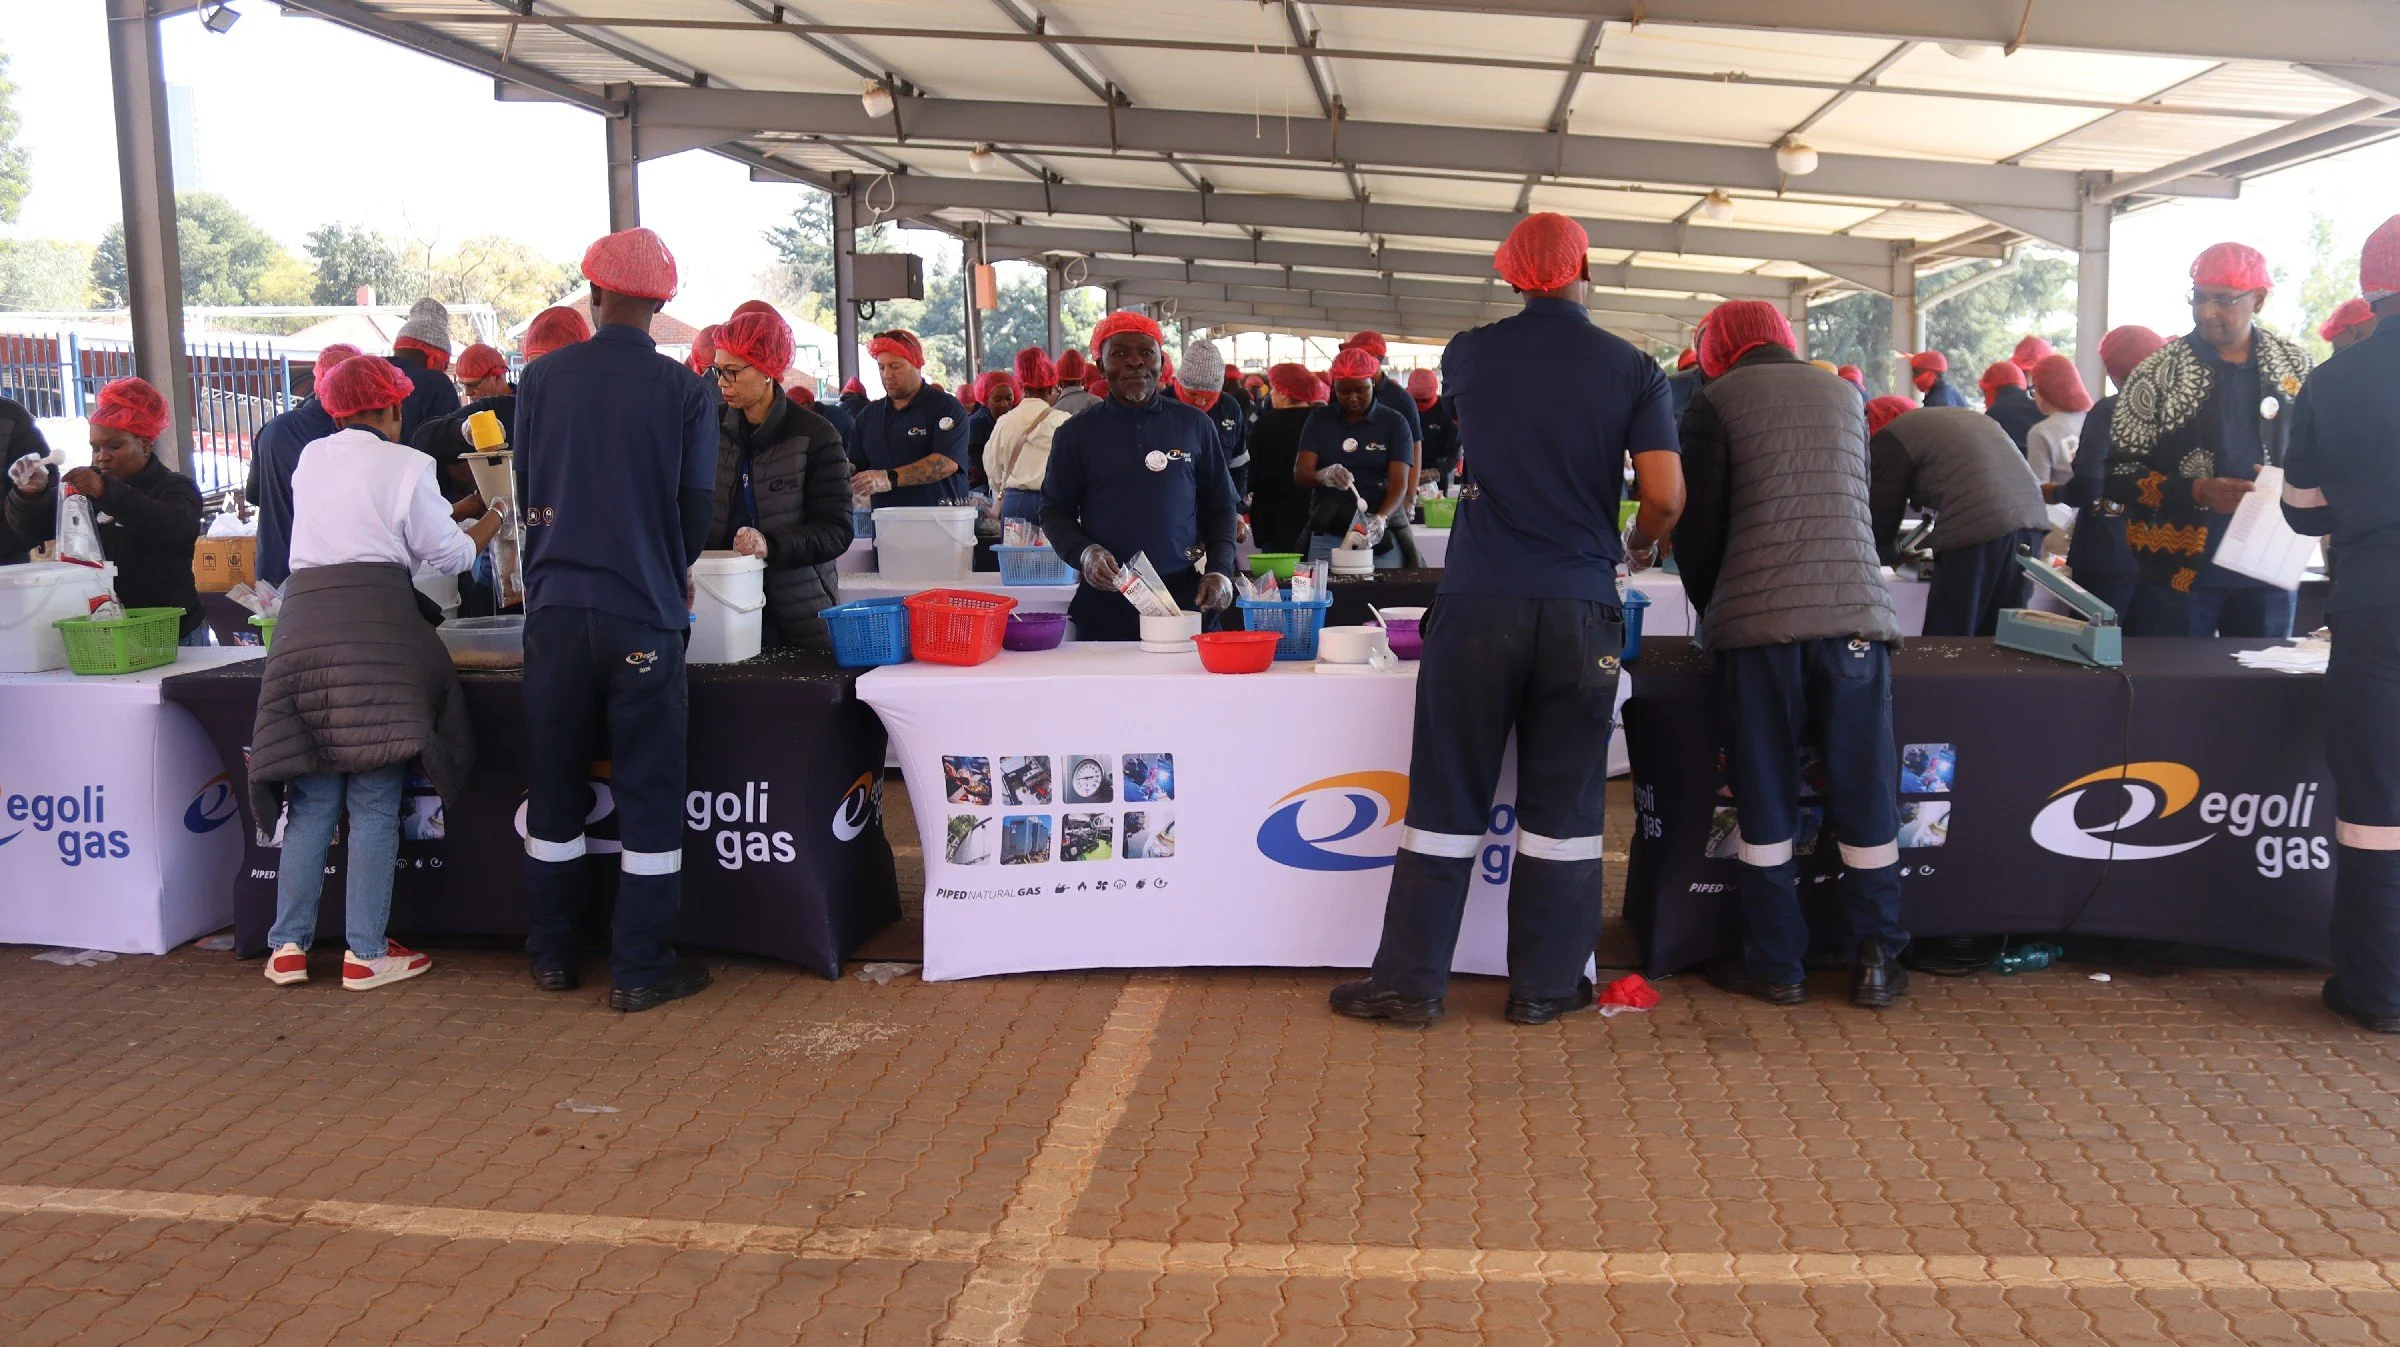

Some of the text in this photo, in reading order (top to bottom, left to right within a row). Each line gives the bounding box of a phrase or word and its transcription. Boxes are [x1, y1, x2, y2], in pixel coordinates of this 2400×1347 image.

[7, 785, 104, 832] egoli
[686, 782, 769, 831] goli
[2199, 783, 2319, 837] egoli
[1643, 814, 1662, 840] gas
[58, 830, 130, 867] gas
[716, 830, 796, 870] gas
[2256, 836, 2331, 879] gas
[251, 866, 337, 879] PIPED AS
[1689, 882, 1724, 893] PIPED
[936, 887, 1041, 900] PIPED NATURAL GAS
